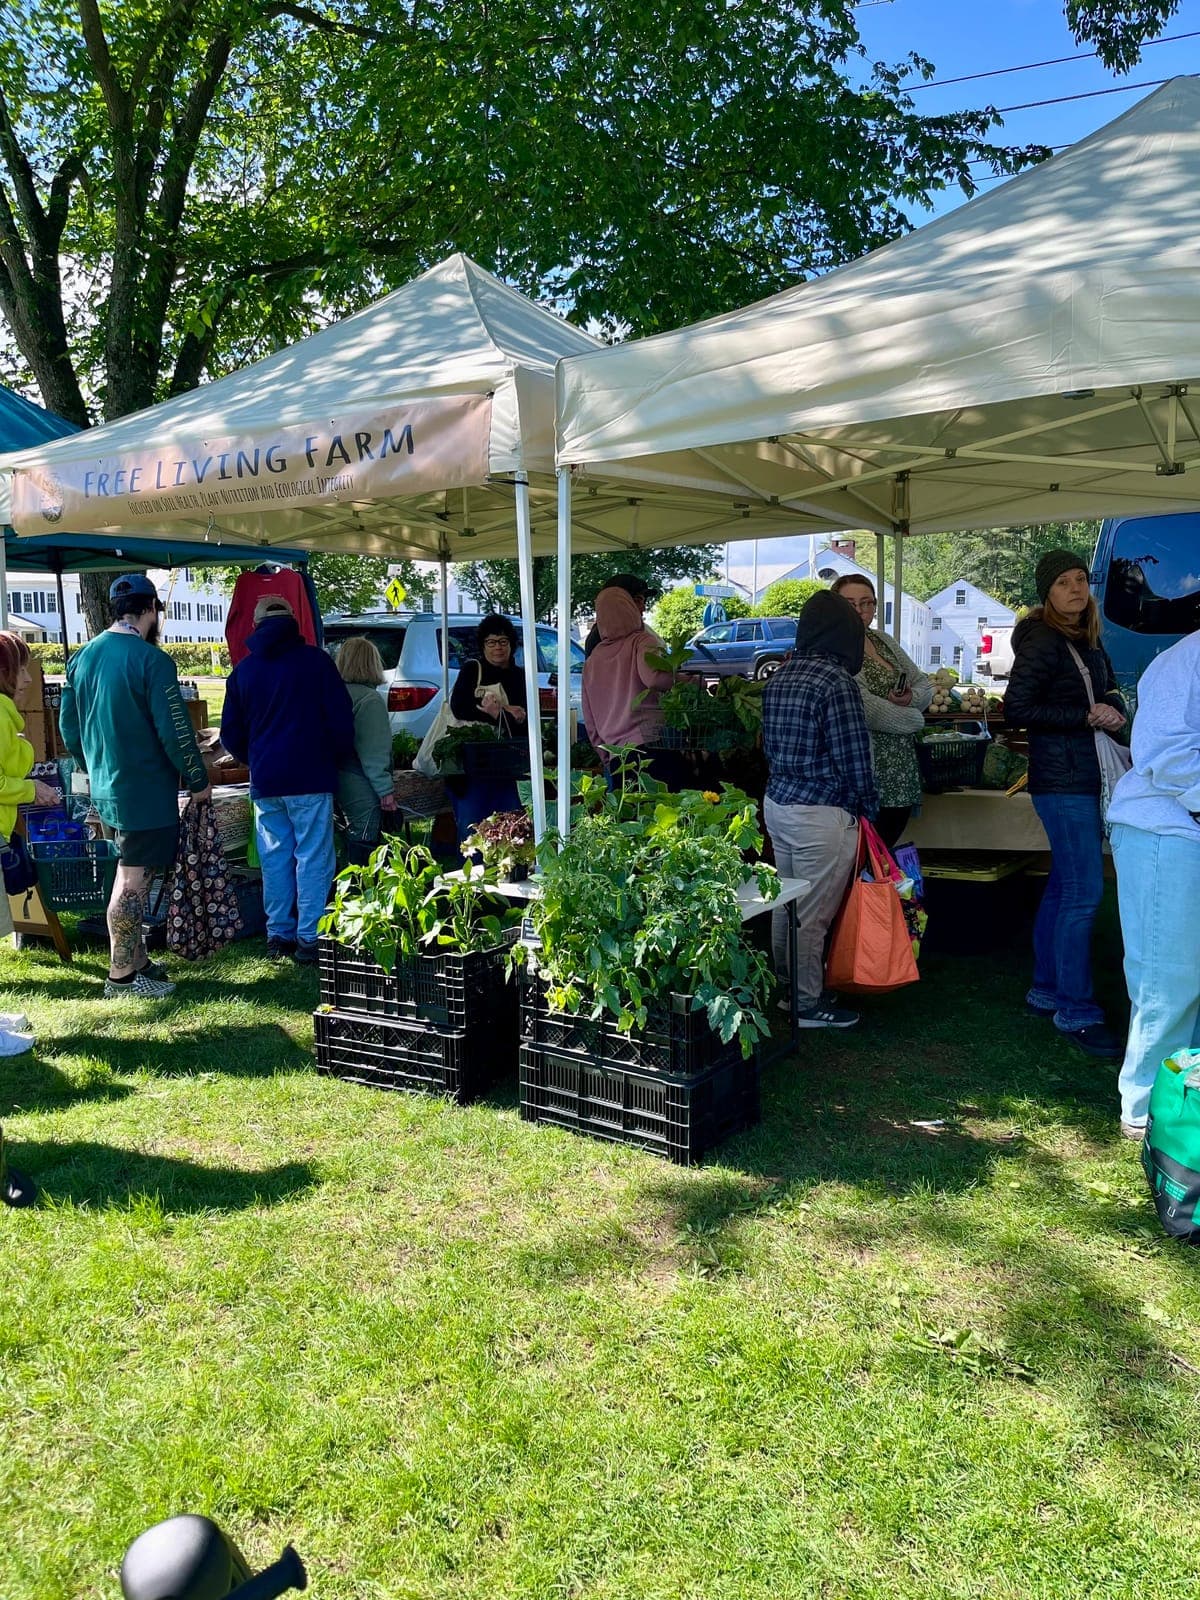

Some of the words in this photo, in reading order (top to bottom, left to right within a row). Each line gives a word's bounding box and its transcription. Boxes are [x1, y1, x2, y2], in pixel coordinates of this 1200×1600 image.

[84, 467, 143, 498] FREE
[155, 445, 287, 490] LIVING
[304, 424, 415, 468] FARM
[128, 500, 154, 515] FOCUSED
[200, 491, 220, 507] PLANT
[220, 486, 260, 505] NUTRITION
[260, 485, 275, 500] AND
[274, 479, 317, 499] ECOLOGICAL
[316, 474, 354, 494] INTEGRITY
